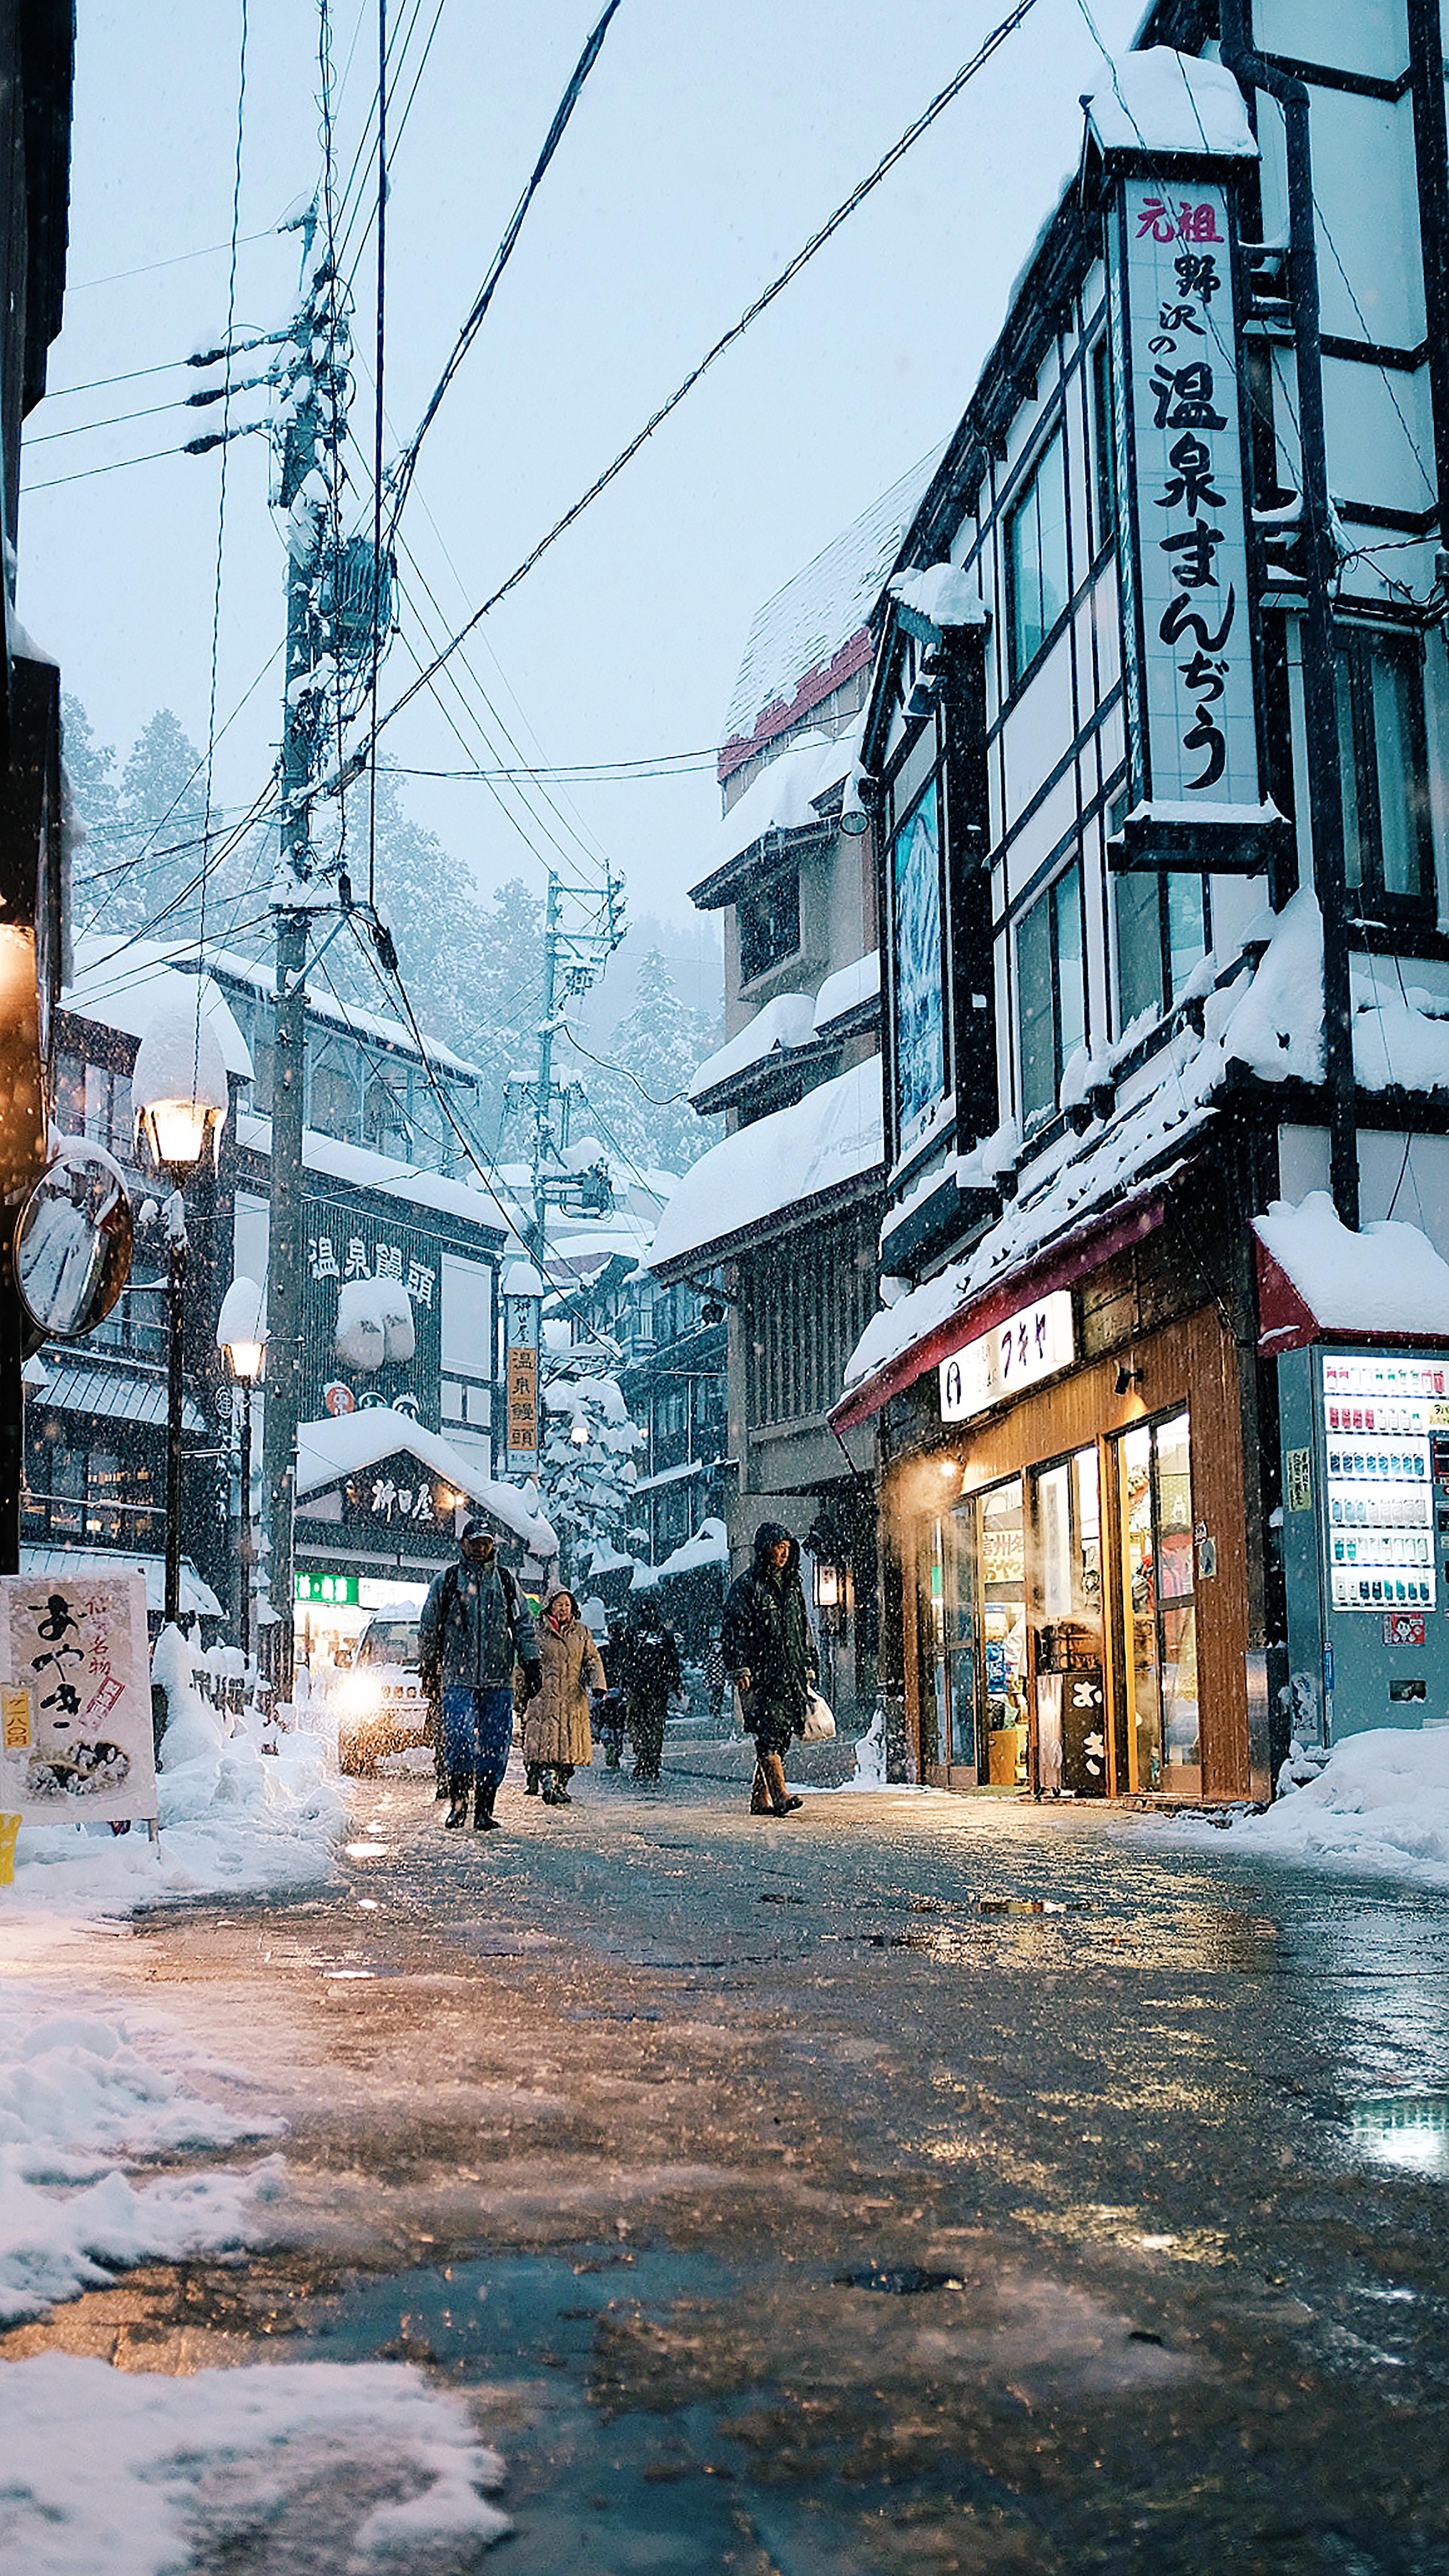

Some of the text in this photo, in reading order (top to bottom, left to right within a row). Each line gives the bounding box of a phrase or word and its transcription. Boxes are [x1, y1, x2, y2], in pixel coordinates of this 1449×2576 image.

[1135, 197, 1224, 243] 元祖
[511, 1352, 534, 1446] 温泉饅頭
[28, 1594, 87, 1729] おやき
